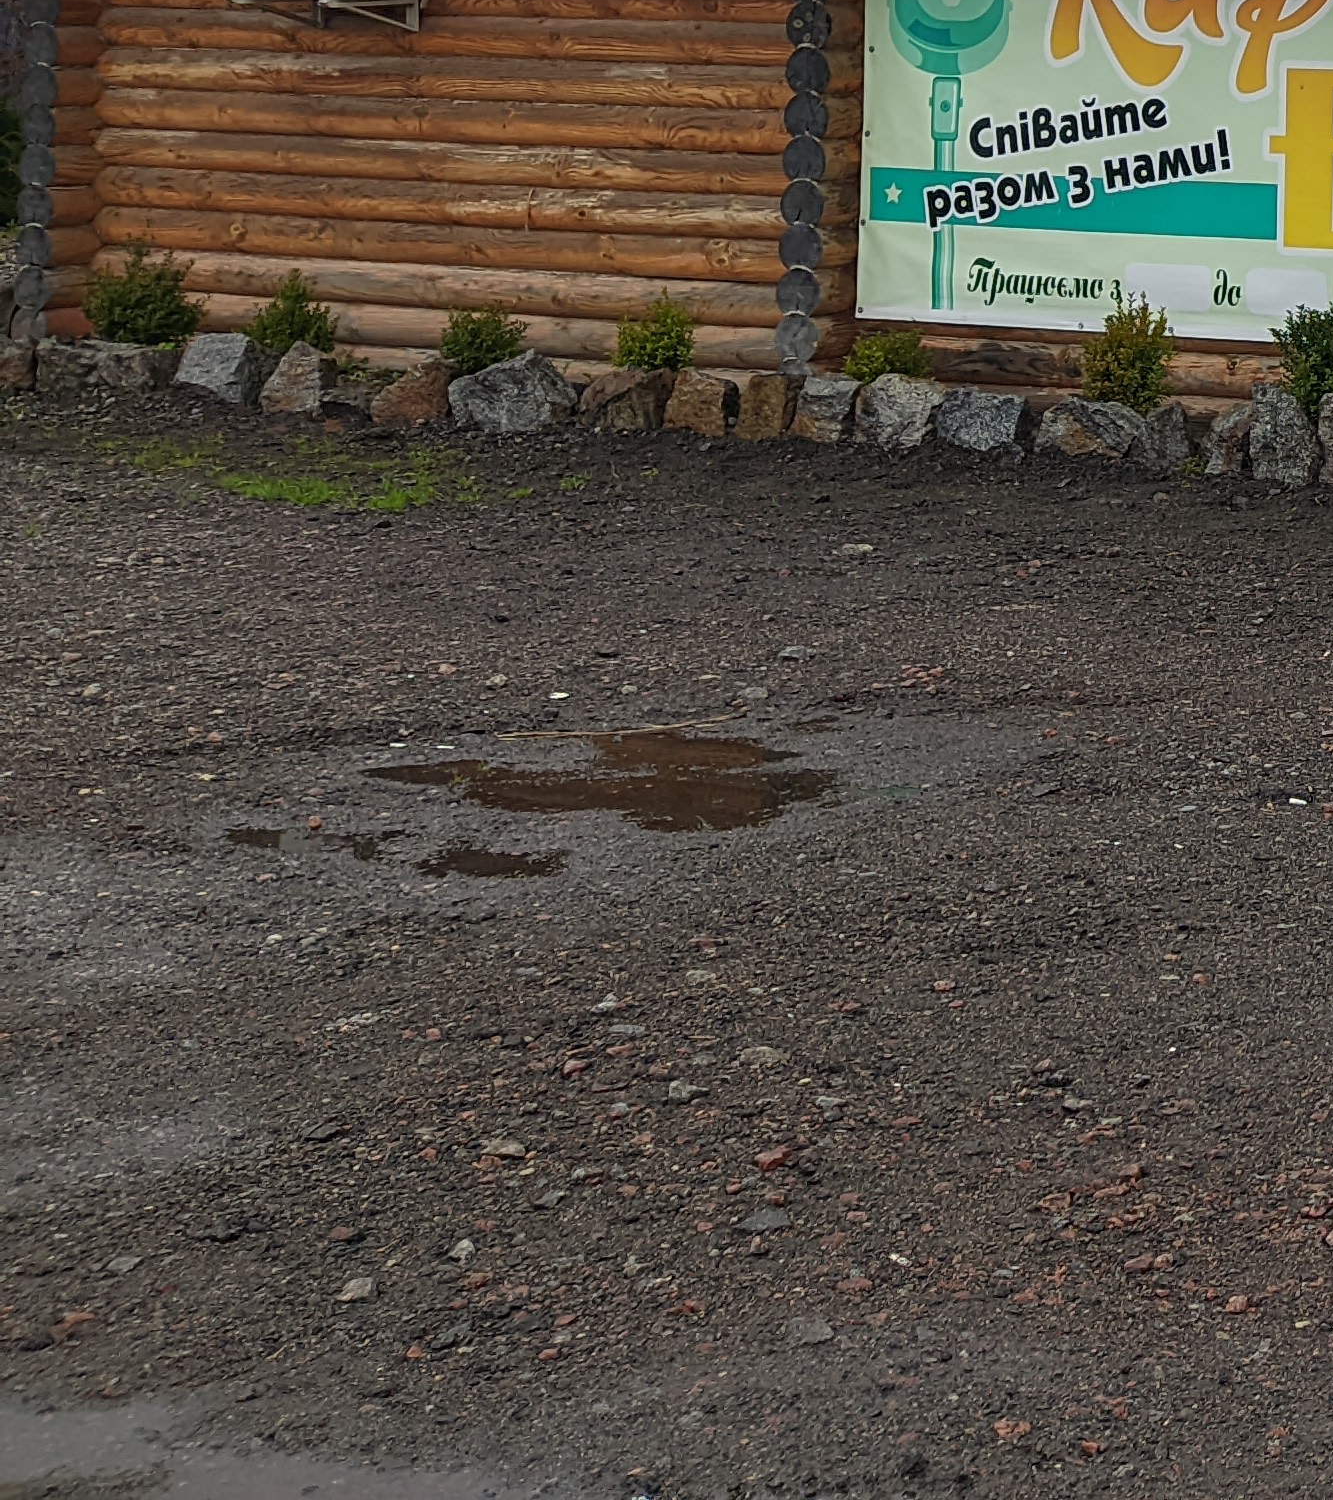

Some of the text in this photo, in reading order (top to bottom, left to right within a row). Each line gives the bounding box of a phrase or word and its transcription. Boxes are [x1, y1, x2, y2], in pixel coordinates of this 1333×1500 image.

[968, 97, 1168, 158] Співайте
[925, 128, 1231, 228] разом з нами!
[966, 257, 1104, 306] Працюємо
[1213, 268, 1242, 307] до
